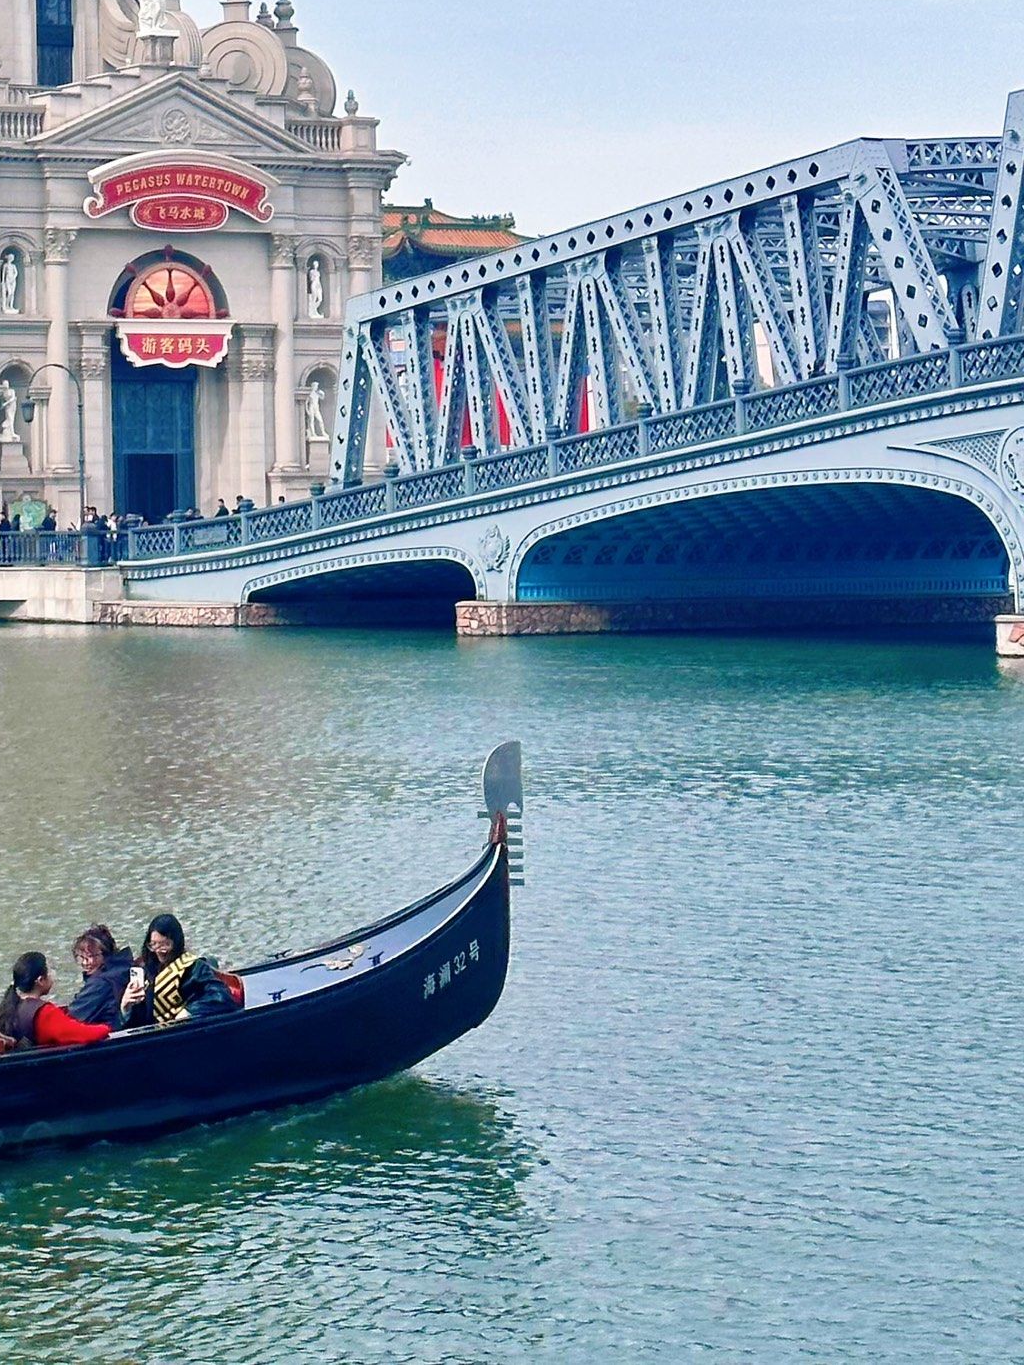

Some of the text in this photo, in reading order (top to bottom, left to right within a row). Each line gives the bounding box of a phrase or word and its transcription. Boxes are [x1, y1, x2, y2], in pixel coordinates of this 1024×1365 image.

[116, 173, 249, 200] PEGASUS WATERTOWN
[155, 206, 205, 220] 飞马水城
[142, 337, 210, 354] 游客码头
